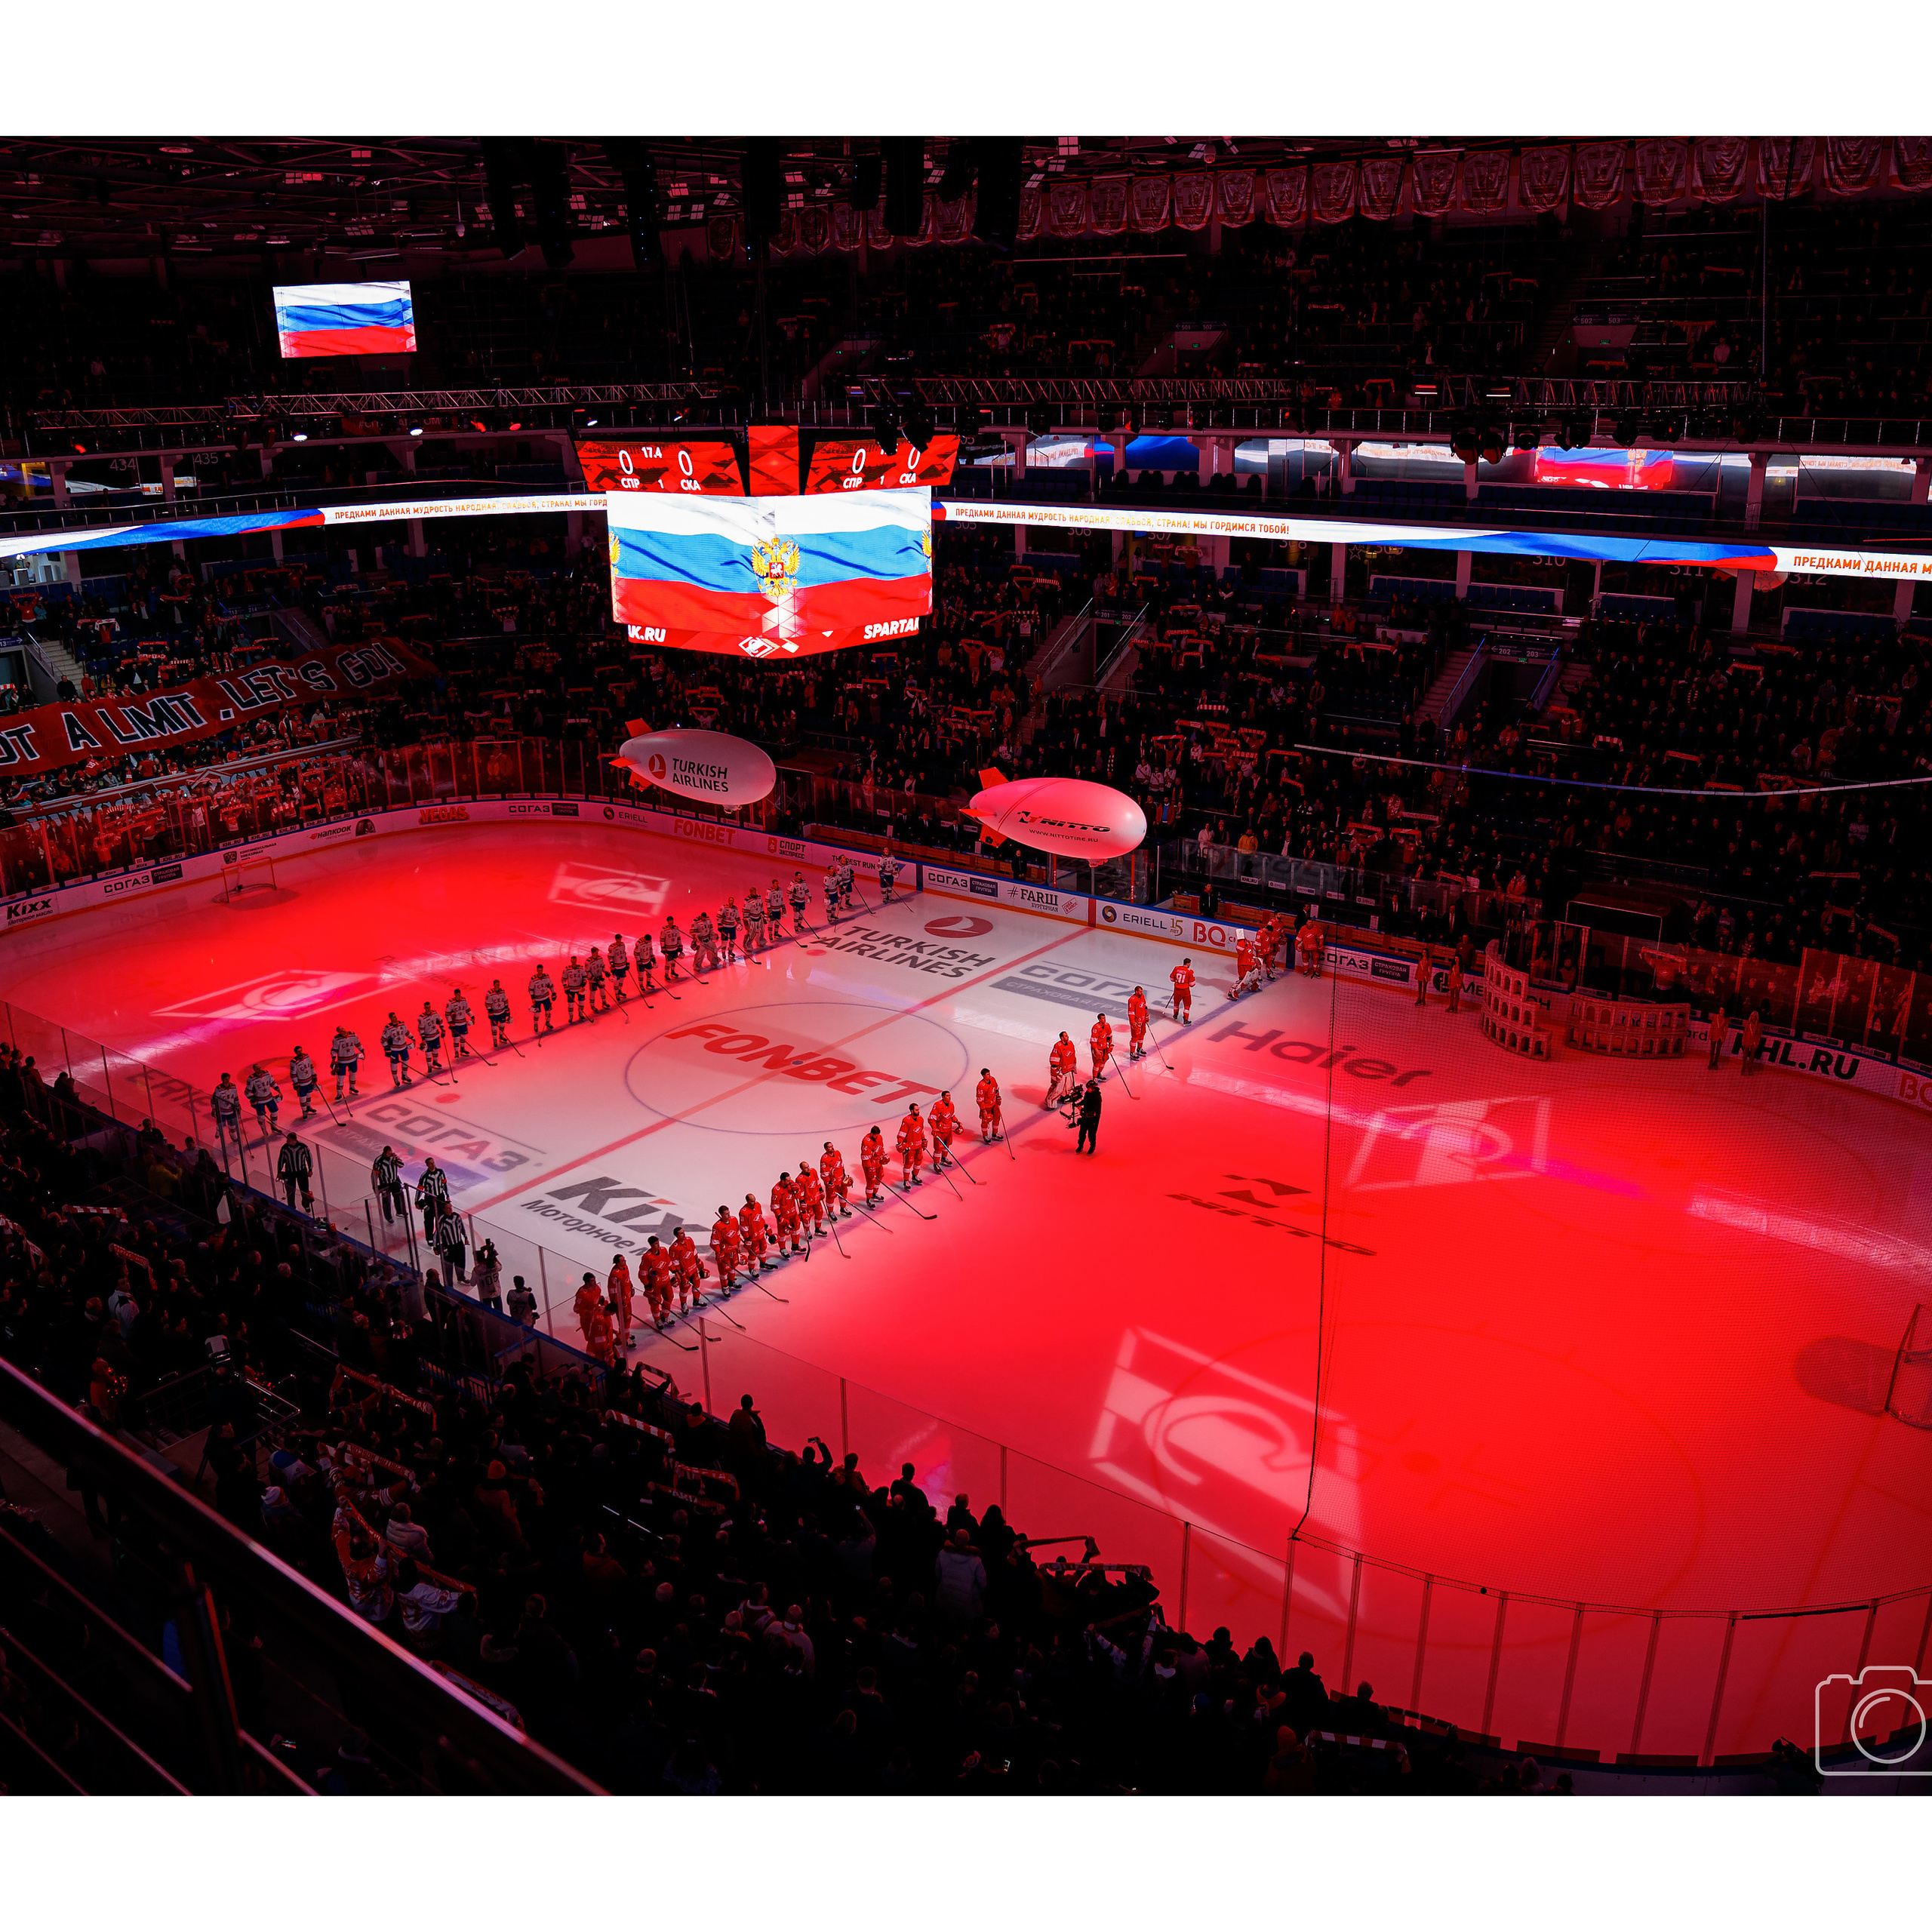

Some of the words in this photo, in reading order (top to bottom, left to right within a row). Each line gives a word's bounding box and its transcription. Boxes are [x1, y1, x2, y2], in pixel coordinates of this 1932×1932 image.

[618, 450, 634, 475] 0
[641, 447, 663, 459] 17.4
[851, 448, 866, 475] 0
[109, 459, 137, 471] 434
[678, 450, 693, 476] 0
[620, 476, 640, 489] СПР
[680, 478, 702, 491] СКА
[842, 477, 863, 490] СПР
[900, 472, 917, 485] СКА
[335, 509, 377, 520] ПРЕДКАМИ
[379, 506, 411, 518] ДАННАЯ
[413, 504, 454, 515] МУДРОСТЬ
[575, 498, 587, 507] МЫ
[955, 508, 994, 518] ПРЕДКАМИ
[996, 509, 1026, 519] ДАННАЯ
[1028, 512, 1067, 521] МУДРОСТЬ
[1193, 520, 1208, 529] МЫ
[1210, 521, 1256, 532] ГОРДИМСЯ
[1259, 521, 1289, 534] ТОБОЙ!
[1793, 555, 1861, 571] ПРЕДКАМИ
[1864, 559, 1918, 574] ДАННАЯ
[61, 712, 103, 751] A
[335, 642, 407, 688] GO!
[672, 757, 728, 780] TURKISH
[672, 772, 729, 792] AIRLINES
[419, 805, 469, 825] VEGAS
[509, 804, 550, 814] СОГАЗ
[619, 811, 648, 824] ERIELL
[674, 817, 737, 845] FONBET
[1039, 817, 1111, 832] NITTO
[1029, 829, 1099, 843] WWW.NITTOTIRE.RU
[778, 849, 805, 860] ЭКСПРЕСС
[779, 839, 806, 854] СПОРТ
[862, 861, 876, 870] RUN
[103, 875, 151, 894] СОГАЗ
[928, 872, 968, 888] СОГАЗ
[7, 898, 52, 921] Kixx
[8, 914, 35, 927] Моторное
[35, 909, 54, 919] масло
[1123, 912, 1168, 931] ERIELL
[1193, 921, 1226, 948] BQ
[842, 926, 996, 968] TURKISH
[812, 936, 974, 979] AIRLINES
[1374, 961, 1407, 974] СТРАХОВАЯ
[1206, 1020, 1432, 1087] Haier
[663, 1023, 949, 1104] FONBET
[365, 1103, 530, 1172] СОГАЗ
[520, 1199, 641, 1250] Моторное
